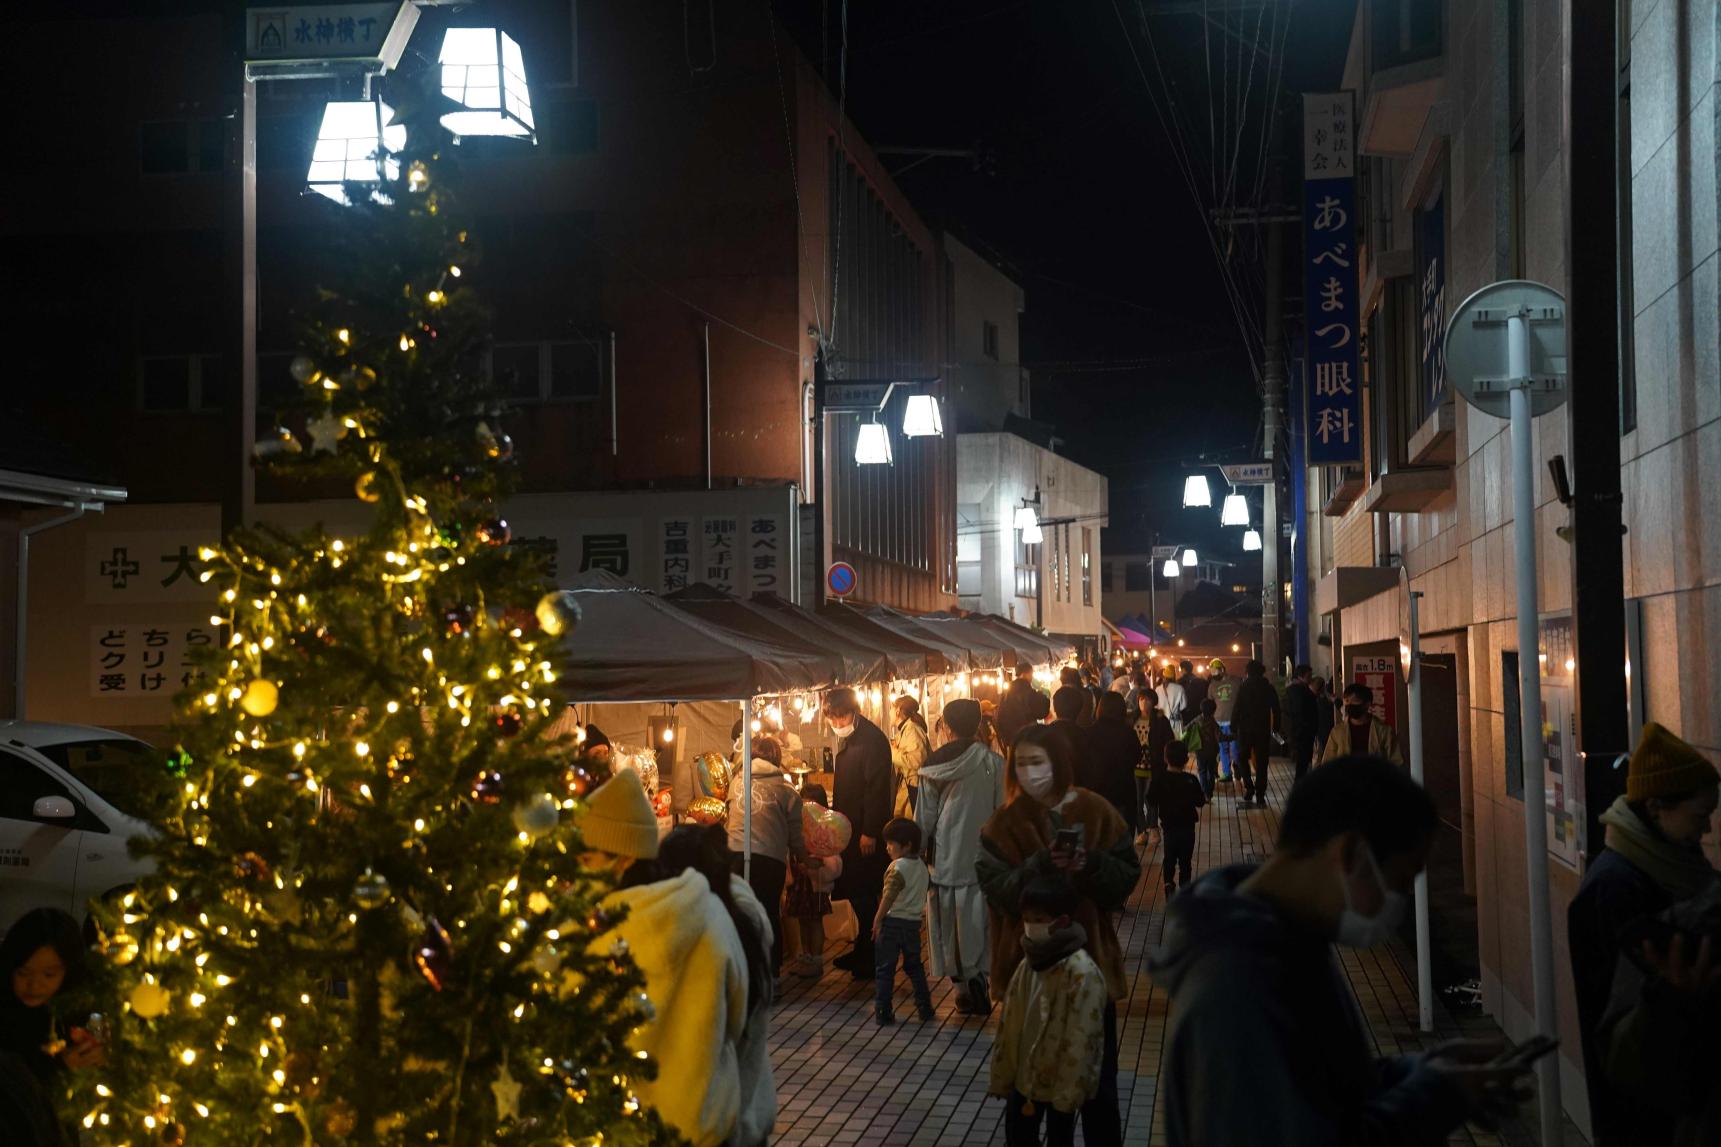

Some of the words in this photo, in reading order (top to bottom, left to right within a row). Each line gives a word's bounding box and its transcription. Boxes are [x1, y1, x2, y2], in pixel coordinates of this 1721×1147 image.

[295, 16, 377, 43] 水神横丁
[1333, 103, 1347, 168] 医療法人
[1312, 195, 1354, 445] あべまつ眼科
[664, 521, 689, 591] 吉重内科
[751, 519, 777, 600] あべまつ
[100, 629, 211, 648] どちら
